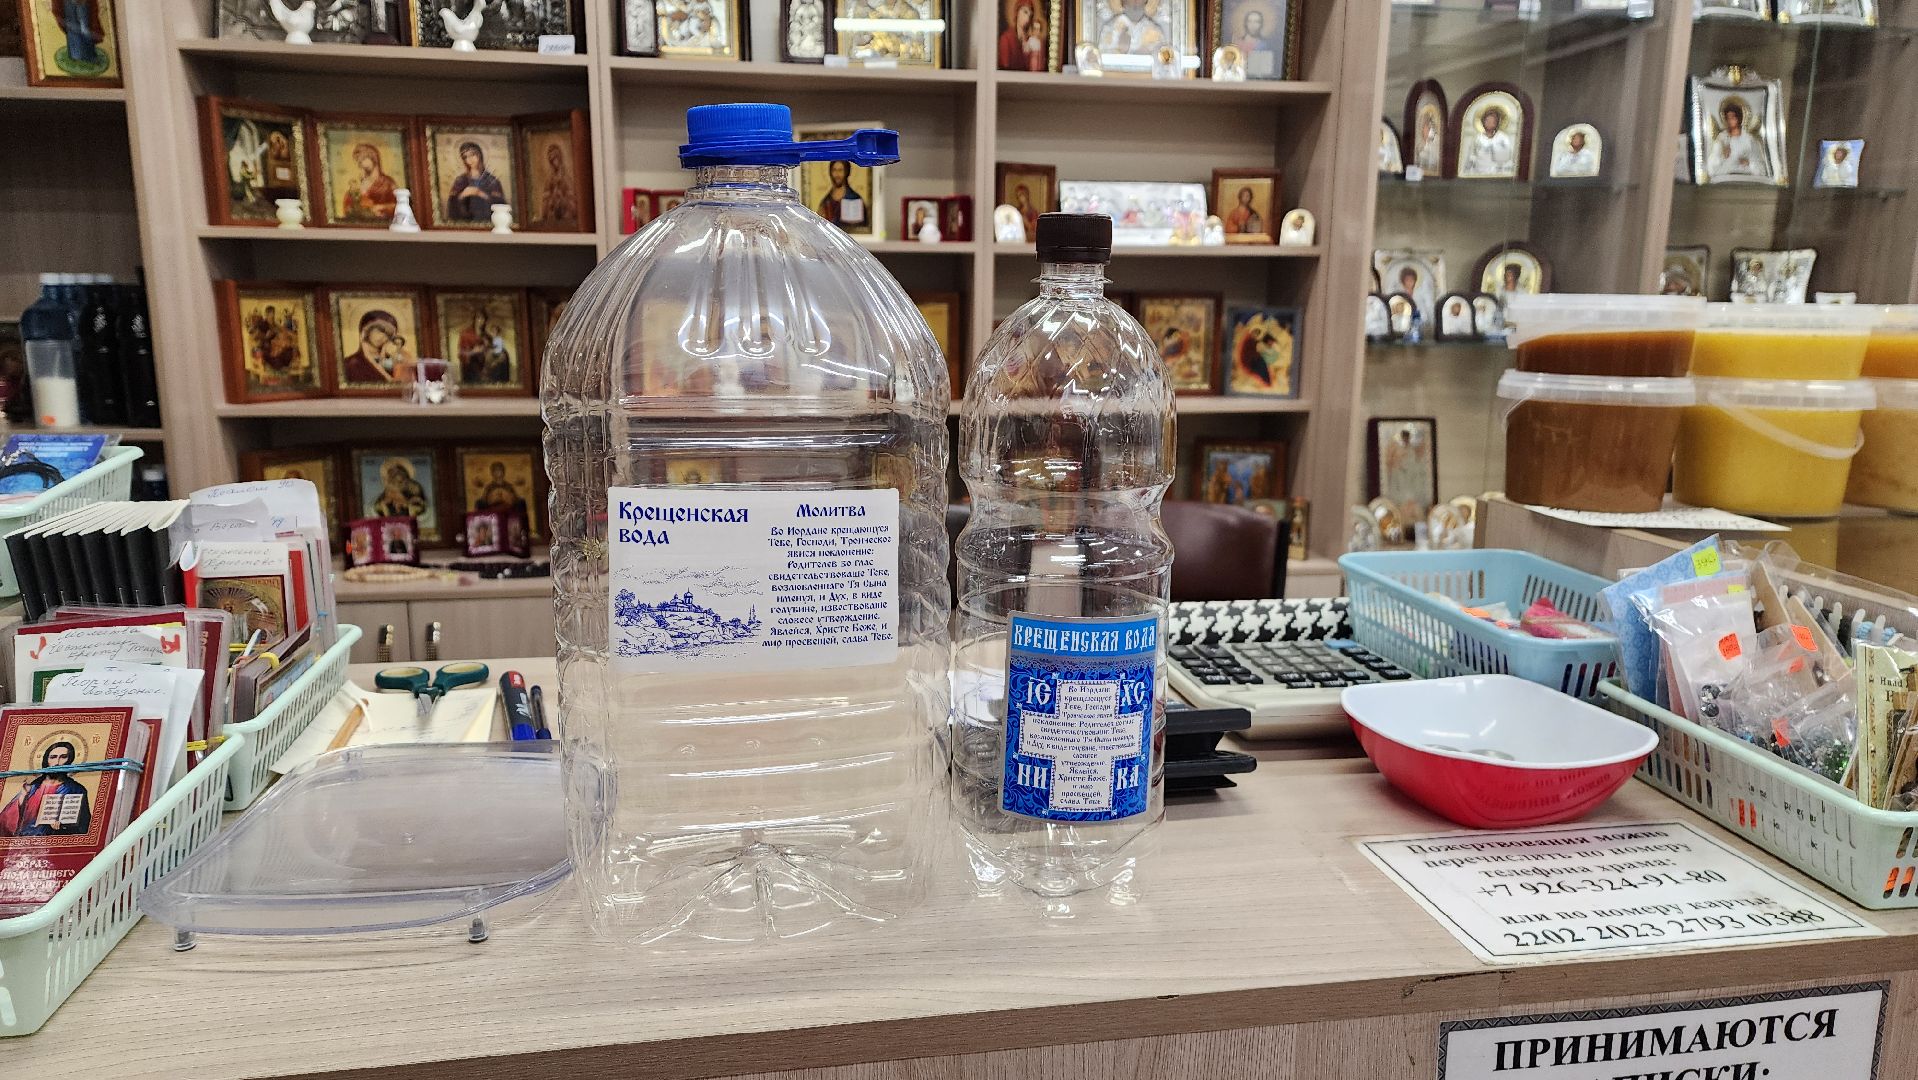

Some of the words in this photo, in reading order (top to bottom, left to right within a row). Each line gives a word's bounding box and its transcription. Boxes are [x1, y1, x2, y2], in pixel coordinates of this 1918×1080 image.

[619, 501, 749, 526] Крещенская
[796, 503, 866, 518] Молитва
[619, 528, 670, 547] вода
[771, 526, 784, 536] Во
[787, 525, 828, 537] Иордане
[762, 640, 782, 649] мир
[1014, 624, 1119, 653] КРЕЩЕНСКАЯ
[1125, 625, 1155, 650] ВОДА
[1407, 836, 1590, 854] Пожертвования
[1593, 831, 1669, 844] можно
[1423, 852, 1571, 868] перечислить
[1576, 850, 1604, 858] по
[1609, 842, 1692, 856] номеру
[1479, 864, 1592, 878] телефона
[1599, 856, 1677, 873] храма:
[1476, 883, 1513, 897] +7
[1520, 869, 1727, 896] 926-324-91-80
[1500, 911, 1550, 924] или
[1555, 909, 1588, 919] по
[1593, 901, 1684, 917] номеру
[1504, 928, 1585, 946] 2202
[1587, 923, 1666, 940] 2023
[1667, 915, 1745, 934] 2793
[1747, 909, 1825, 927] 0388
[1493, 1009, 1839, 1072] ПРИНИМАЮТСЯ
